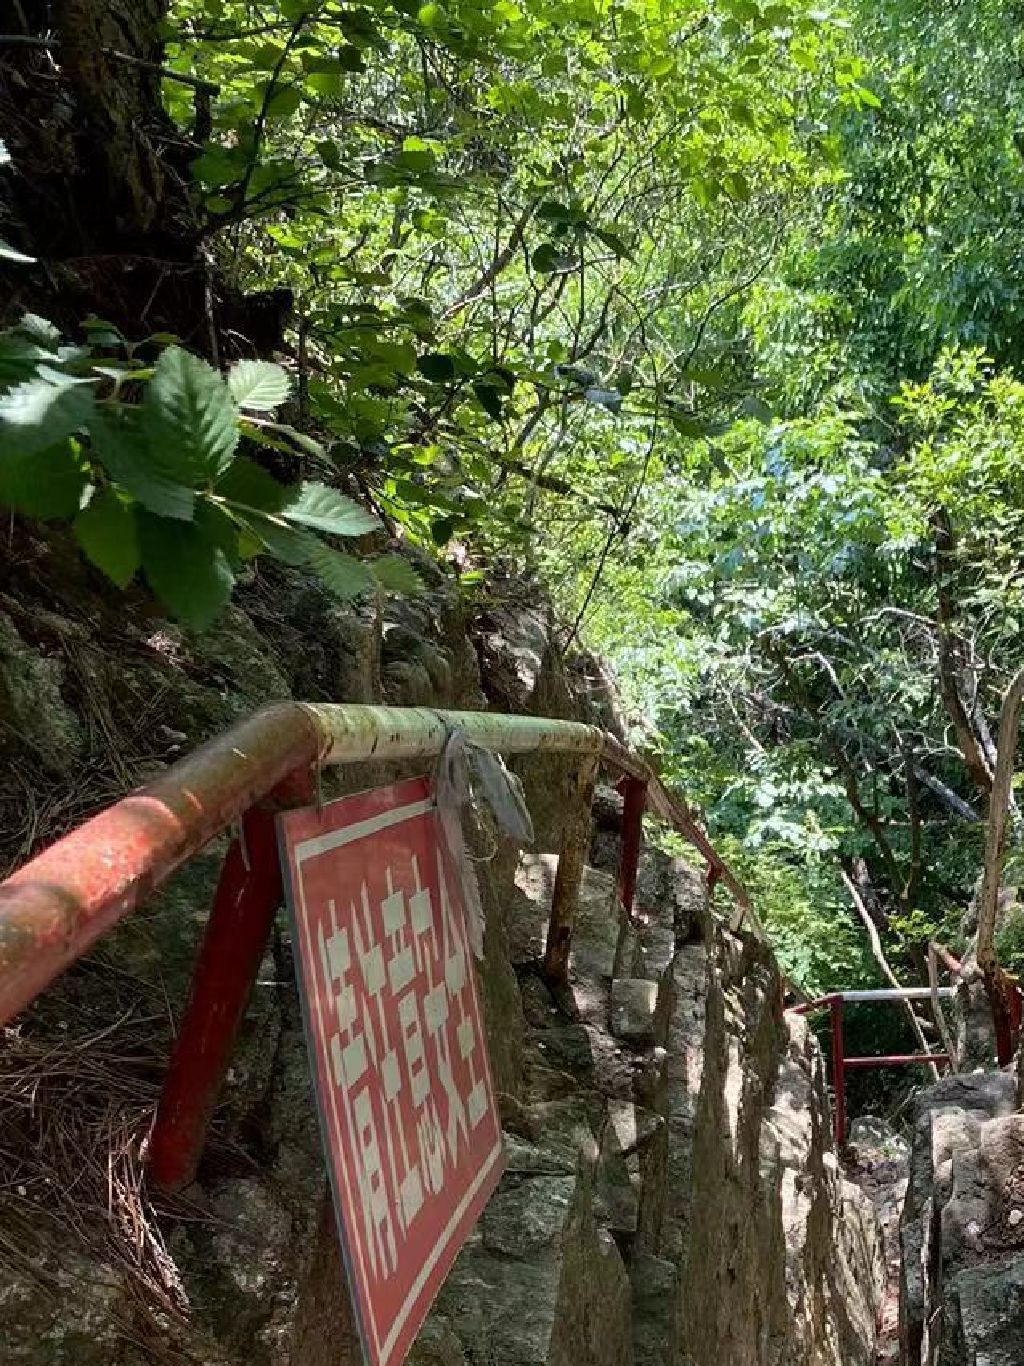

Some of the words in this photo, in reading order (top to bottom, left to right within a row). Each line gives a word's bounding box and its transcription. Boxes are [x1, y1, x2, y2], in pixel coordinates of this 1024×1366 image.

[318, 847, 489, 1278] 请注意安全
